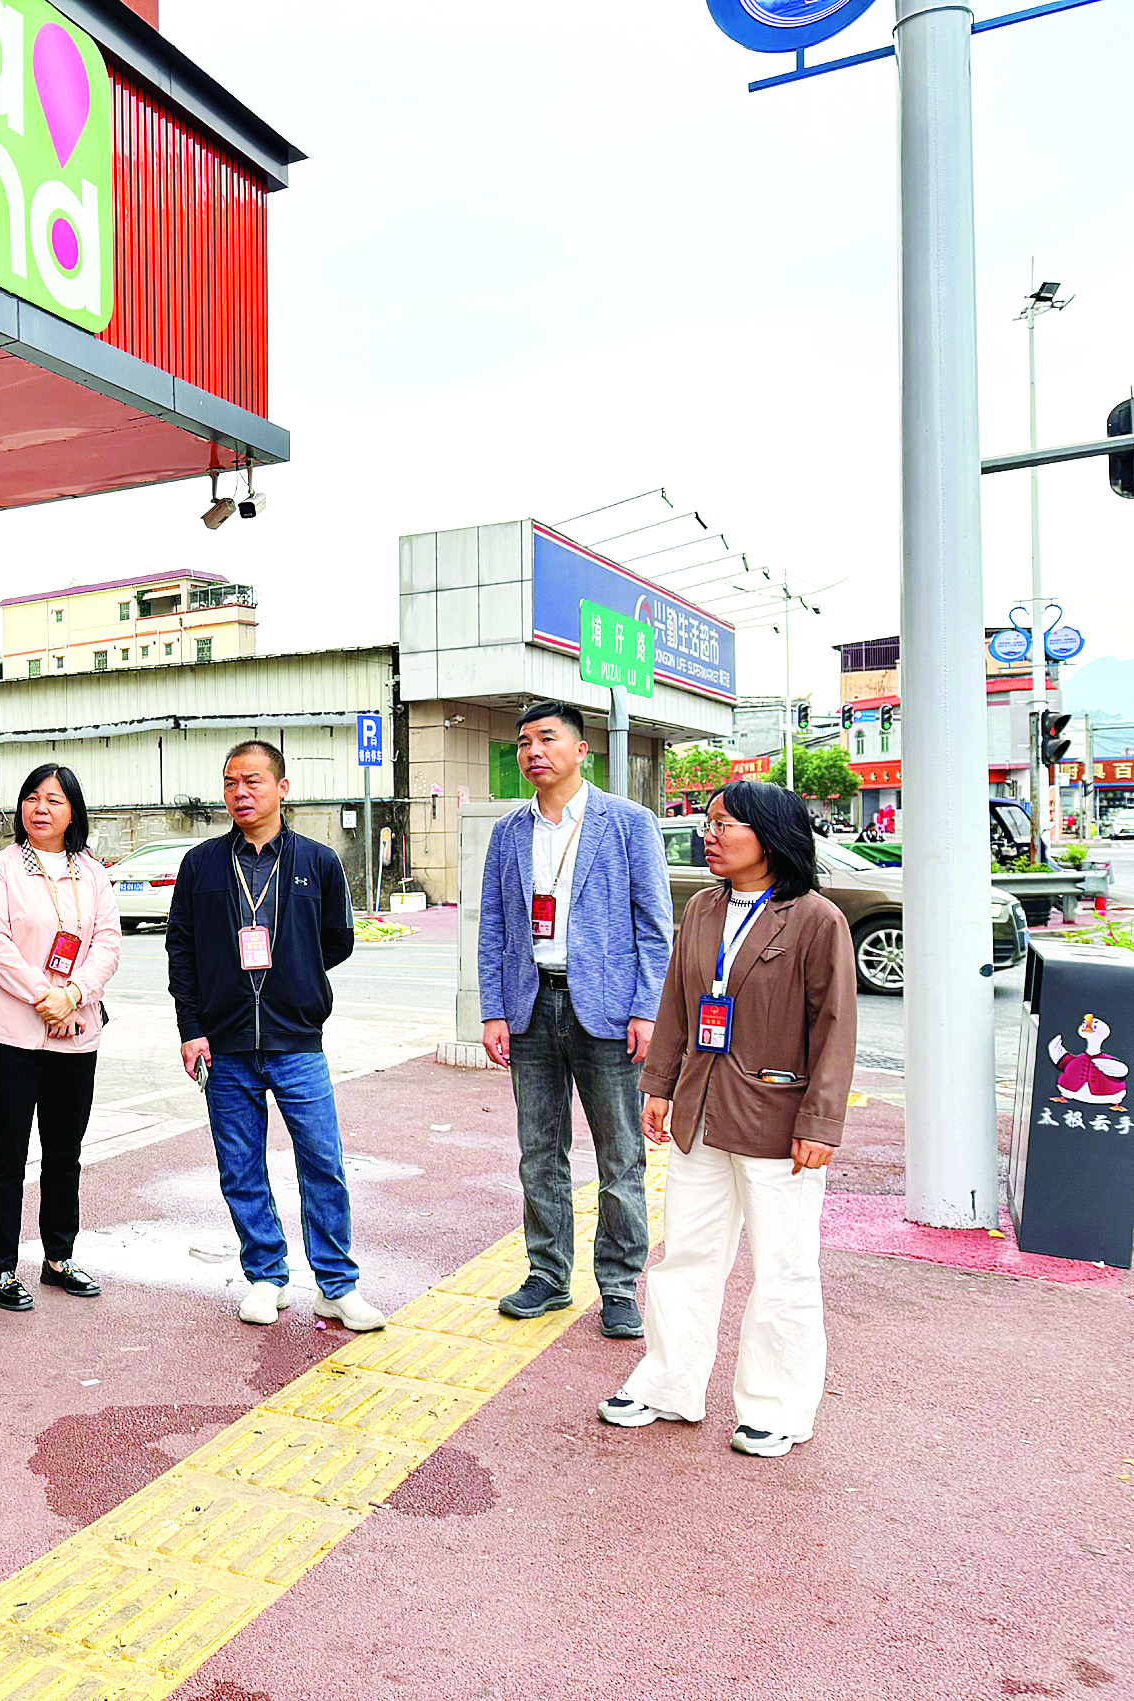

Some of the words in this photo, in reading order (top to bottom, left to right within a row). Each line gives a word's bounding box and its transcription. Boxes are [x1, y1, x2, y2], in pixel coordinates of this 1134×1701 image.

[592, 613, 646, 662] 埔仔路
[601, 661, 621, 683] PUZAI
[627, 668, 636, 686] LU
[363, 719, 376, 746] P
